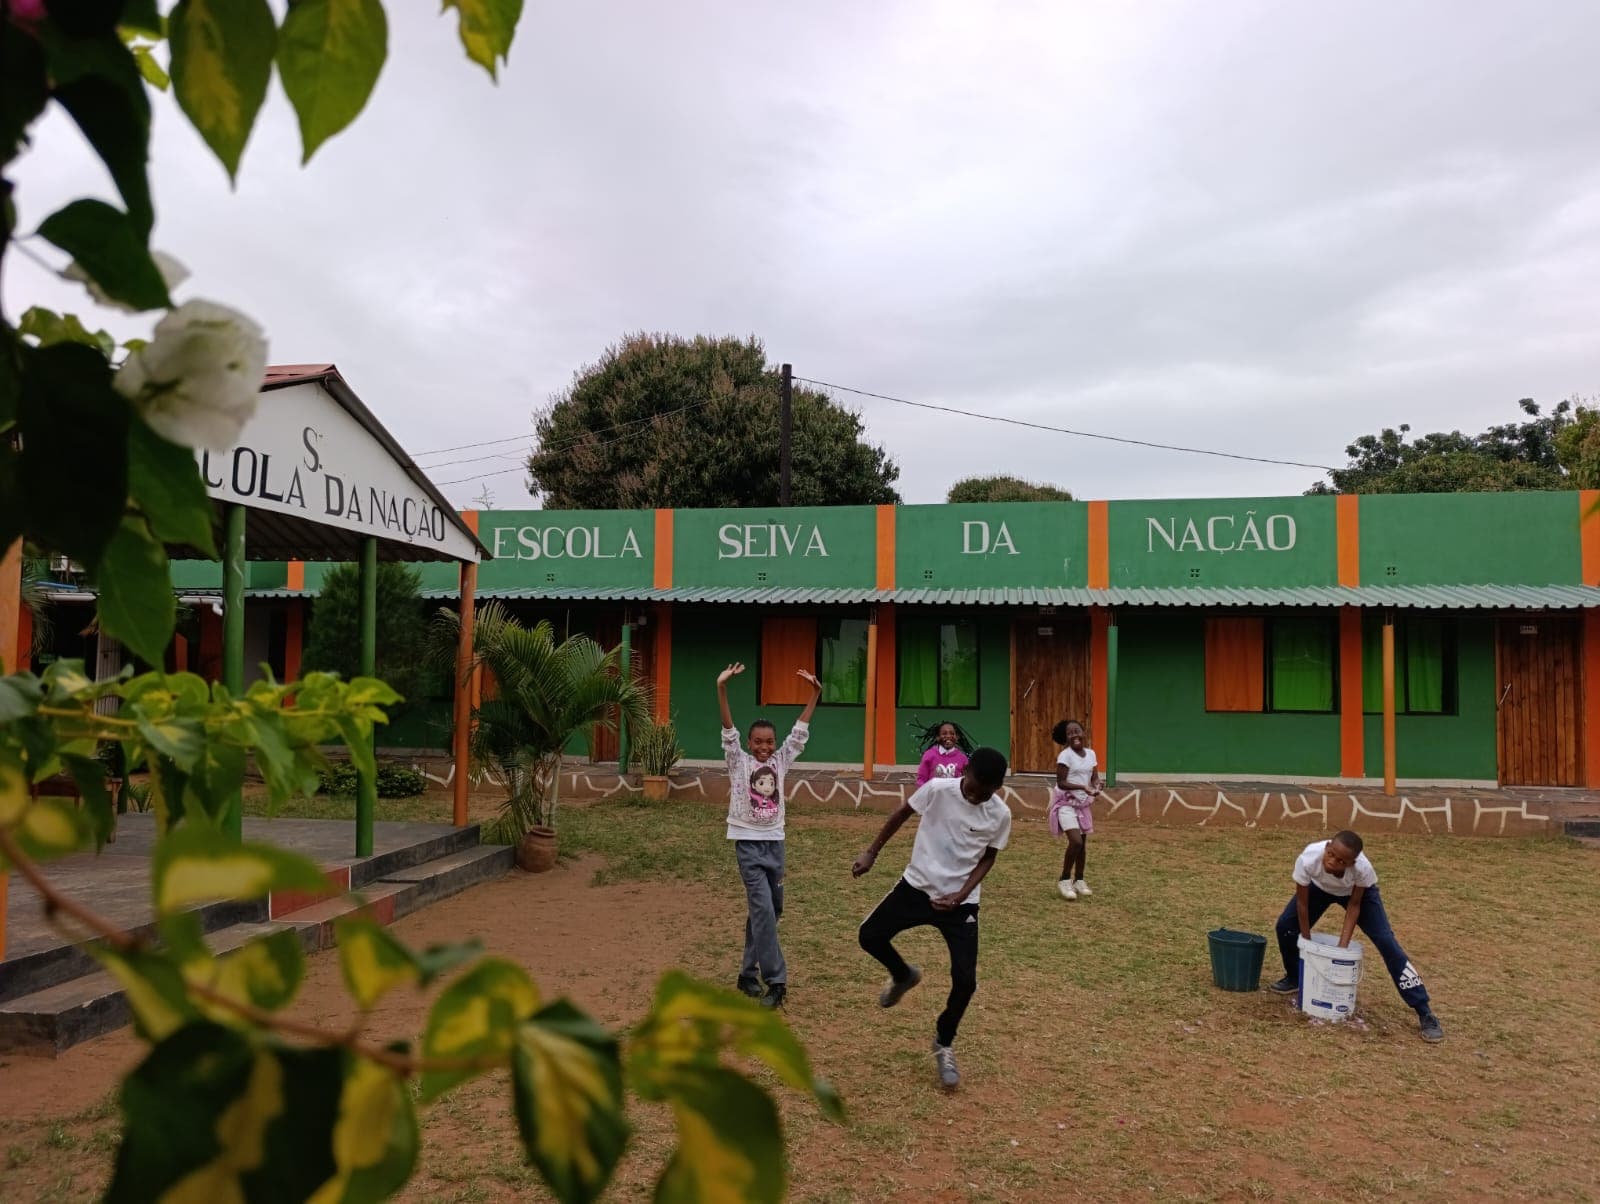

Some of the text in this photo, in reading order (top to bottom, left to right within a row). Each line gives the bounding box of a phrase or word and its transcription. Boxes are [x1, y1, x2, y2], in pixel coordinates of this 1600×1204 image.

[193, 446, 306, 508] COLA
[324, 473, 363, 522] DA
[493, 510, 1296, 560] ESCOLA SEIVA DA NAÇÃO
